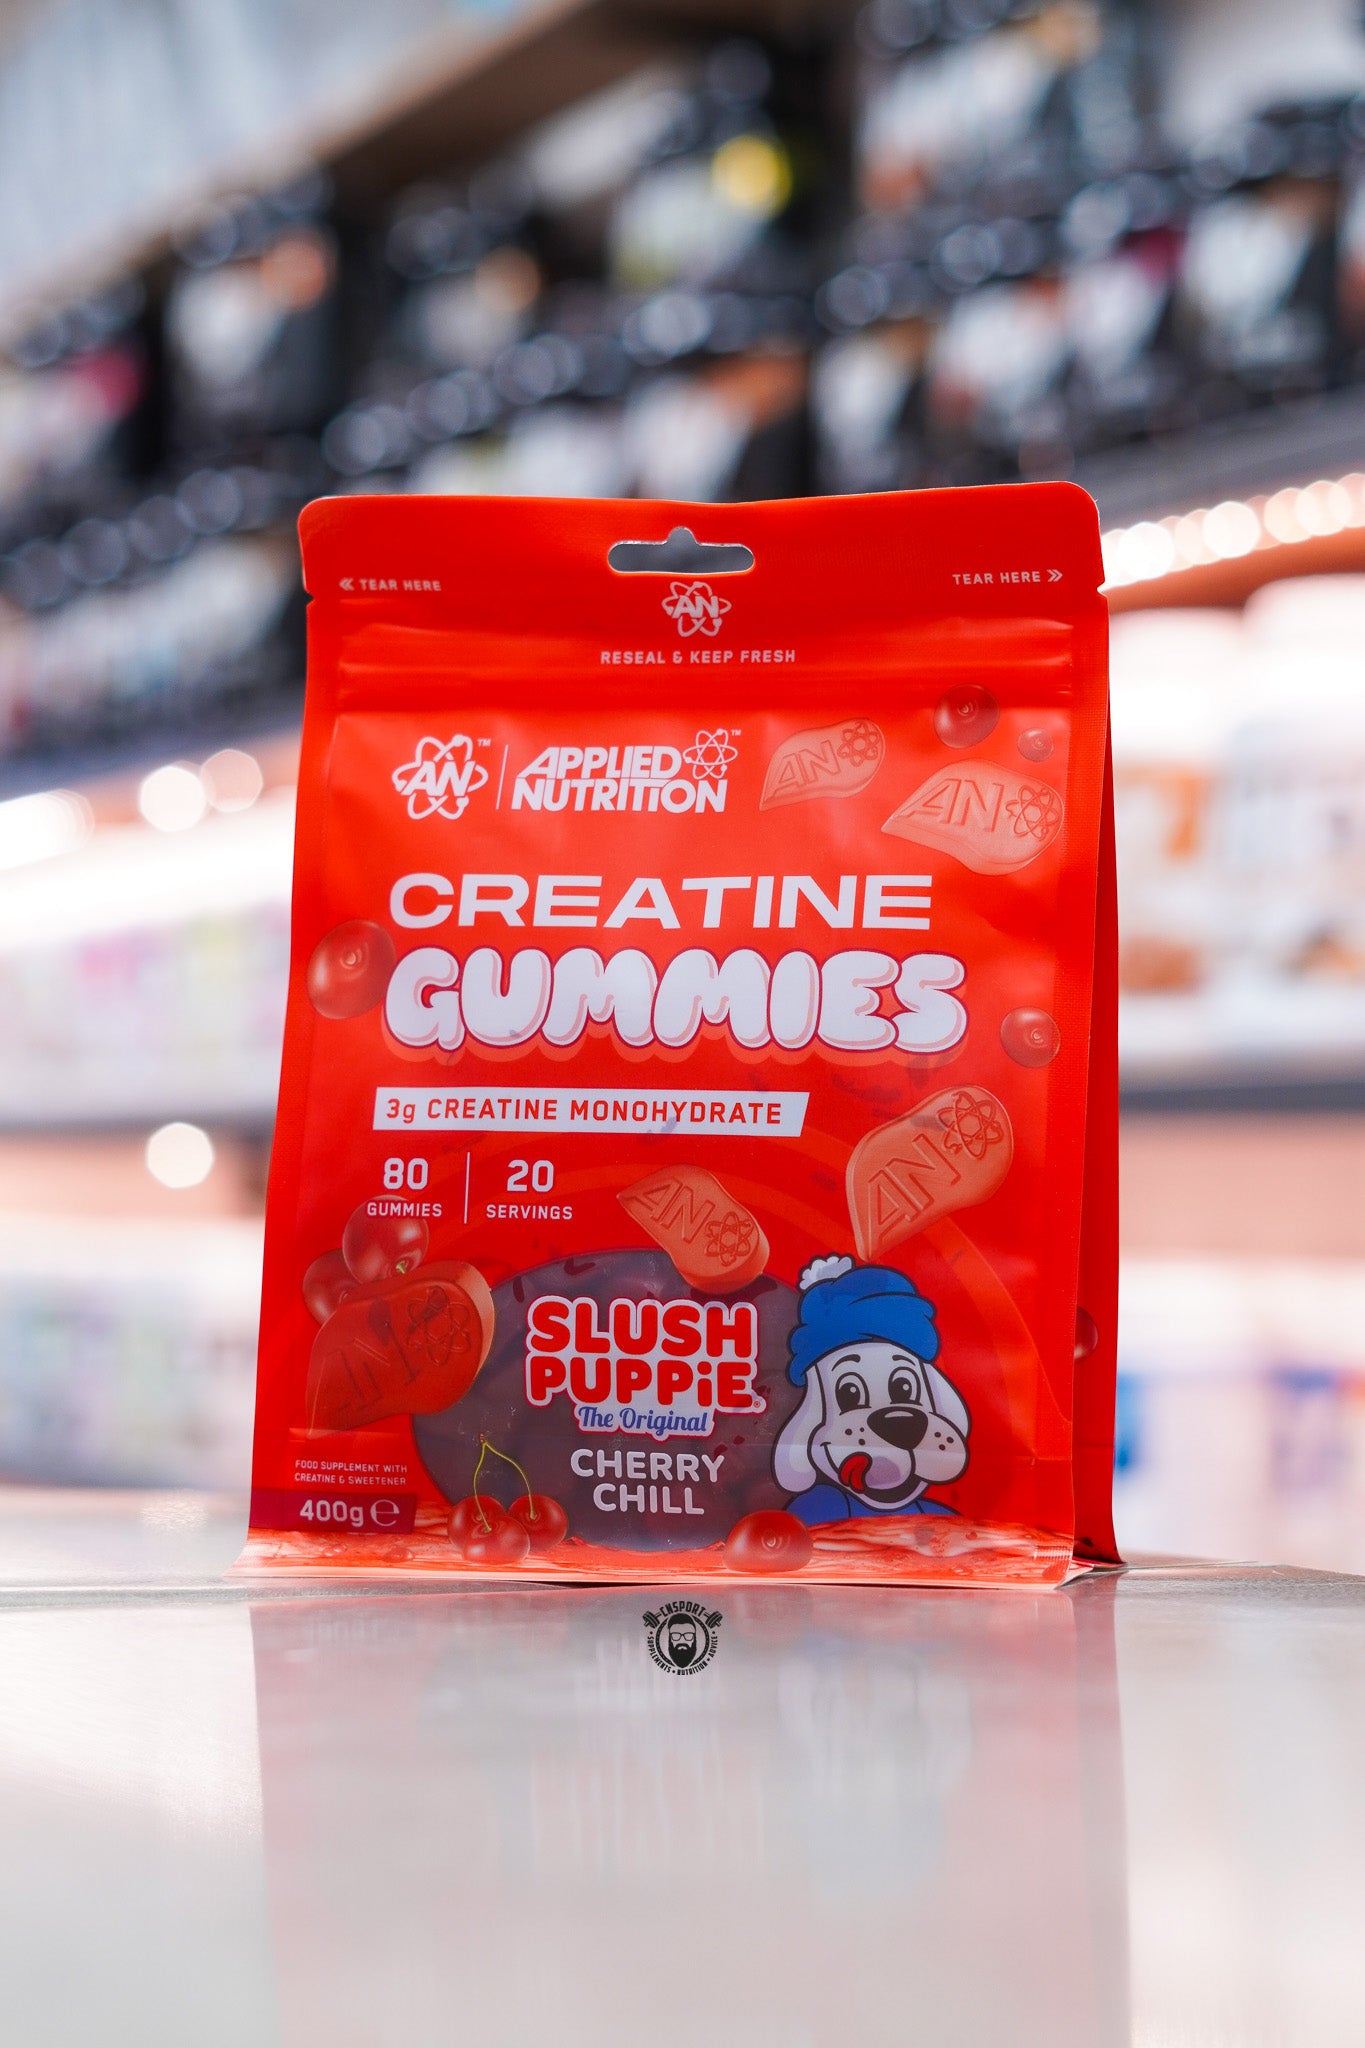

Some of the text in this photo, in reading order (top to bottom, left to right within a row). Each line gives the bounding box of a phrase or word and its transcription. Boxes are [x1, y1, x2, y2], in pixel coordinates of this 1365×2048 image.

[359, 578, 441, 592] TEAR HERE
[952, 571, 1040, 585] TEAR HERE
[600, 649, 796, 664] RESEAL & KEEP FRESH
[516, 746, 682, 779] APPLIED
[511, 777, 728, 813] NUTRITION
[389, 873, 932, 931] CREATINE
[386, 947, 967, 1050] GUMMIES
[386, 1098, 782, 1125] 3g CREATINE MONOHYDRATE
[383, 1157, 429, 1190] 80
[506, 1159, 555, 1192] 20
[367, 1202, 443, 1218] GUMMIES
[486, 1204, 573, 1220] SERVINGS
[530, 1300, 752, 1358] SLUSH
[578, 1406, 708, 1436] The Original
[294, 1473, 407, 1486] CREATINE & SWEETENER
[295, 1460, 408, 1473] FOOD SUPPLEMENT WITH
[570, 1448, 725, 1483] CHERRY
[300, 1499, 364, 1527] 400g
[593, 1483, 705, 1515] CHILL
